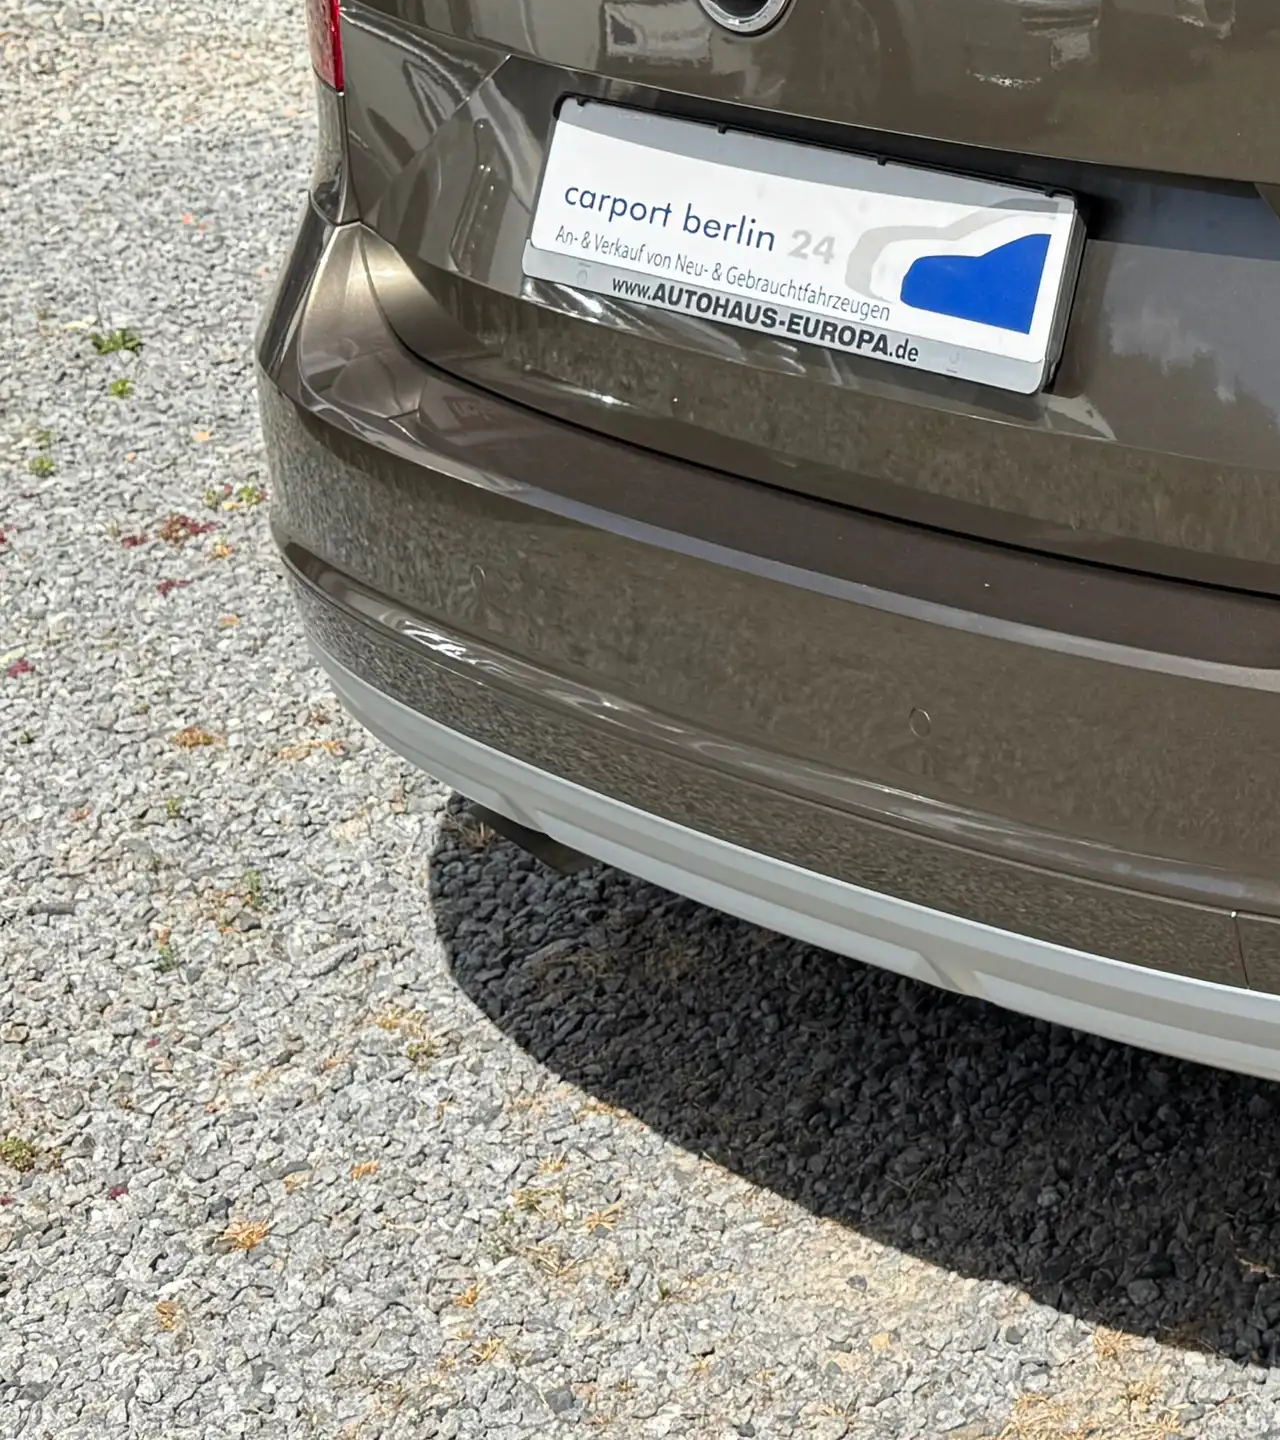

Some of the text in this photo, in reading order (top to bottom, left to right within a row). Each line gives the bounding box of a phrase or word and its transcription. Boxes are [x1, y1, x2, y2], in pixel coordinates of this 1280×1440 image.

[564, 186, 836, 265] carport berlin 24
[555, 224, 891, 322] An- & Verkauf von Neu- & Gebrauchtfahrzeugen
[611, 277, 920, 363] www.AUTOHAUS-EUROPA.de
